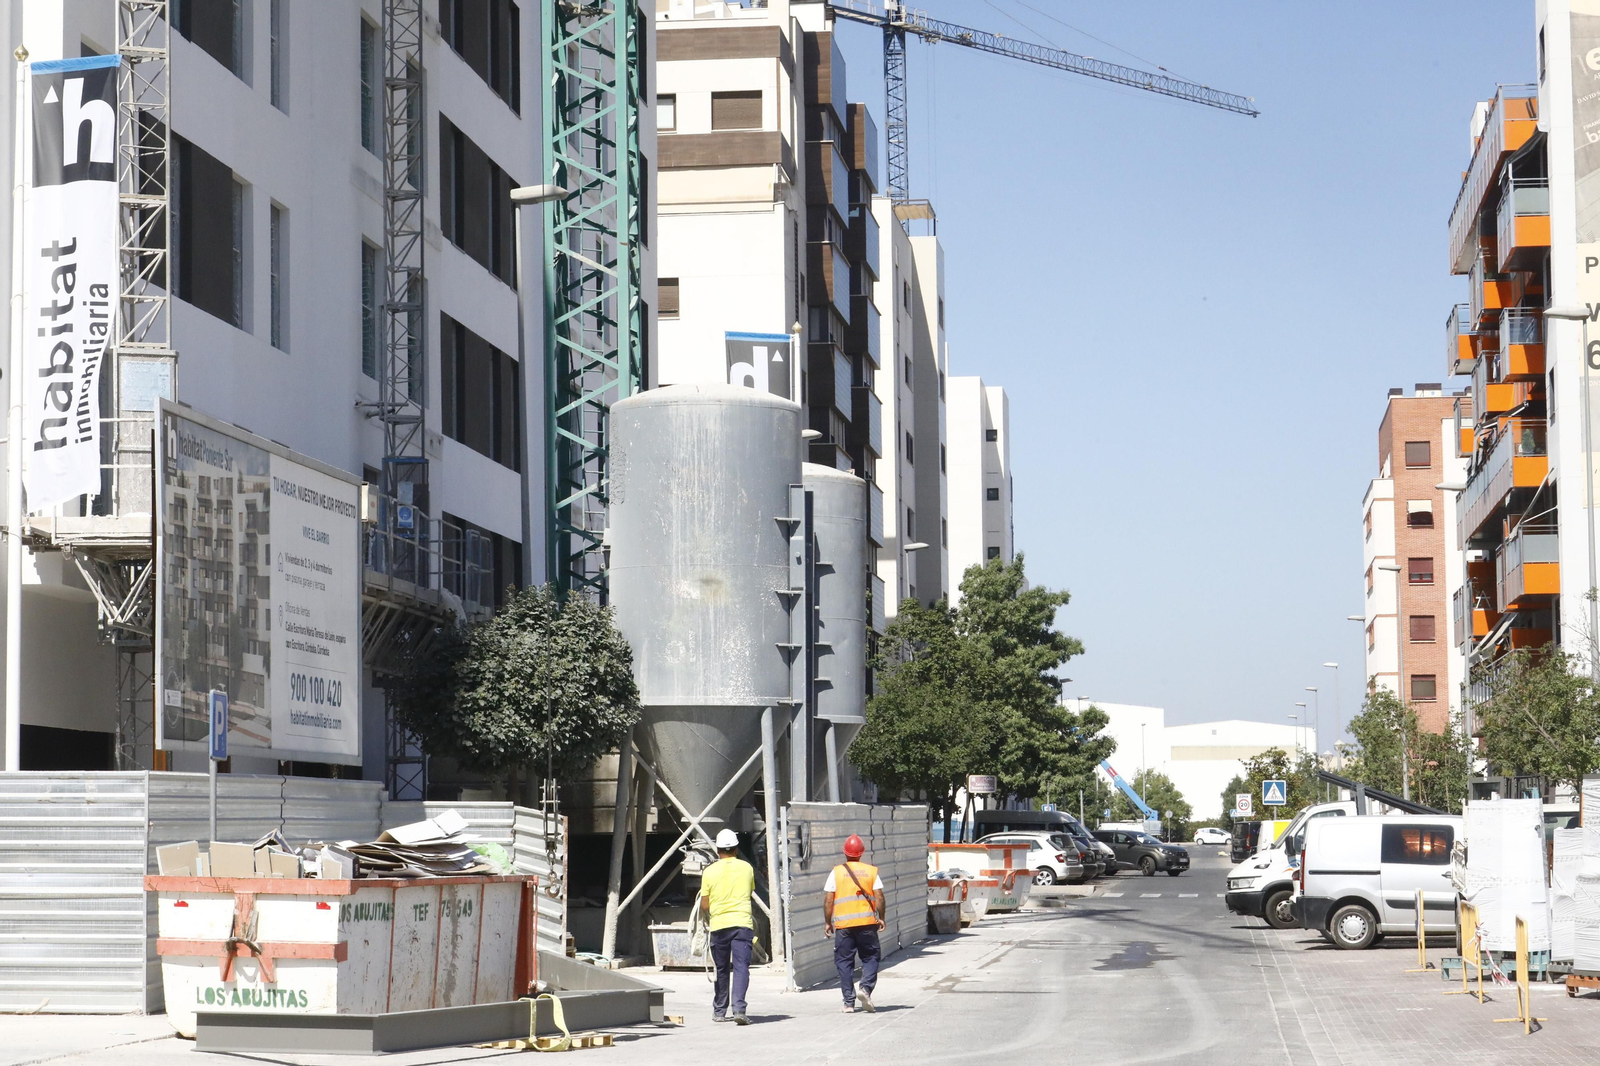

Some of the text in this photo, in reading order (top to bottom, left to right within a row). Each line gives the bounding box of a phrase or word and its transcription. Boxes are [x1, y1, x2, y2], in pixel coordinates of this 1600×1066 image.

[63, 77, 115, 166] h
[34, 236, 77, 452] habitat
[224, 448, 234, 472] Sur
[273, 476, 356, 519] TU HOGAR, NUESTRO MEJOR PROYECTO
[312, 529, 315, 541] EL
[285, 552, 300, 566] Viviendas
[301, 557, 304, 567] de
[308, 559, 310, 569] 3
[313, 560, 315, 570] 4
[316, 561, 332, 575] dormitorios
[285, 602, 310, 618] Oficina de Ventas
[315, 628, 324, 639] Teresa
[325, 630, 328, 640] de
[291, 672, 342, 707] 900 100 420
[215, 701, 224, 750] P
[290, 709, 341, 730] habitatinmobiliaria.com
[413, 903, 429, 922] TEF
[196, 986, 308, 1008] LOS ABUJITAS
